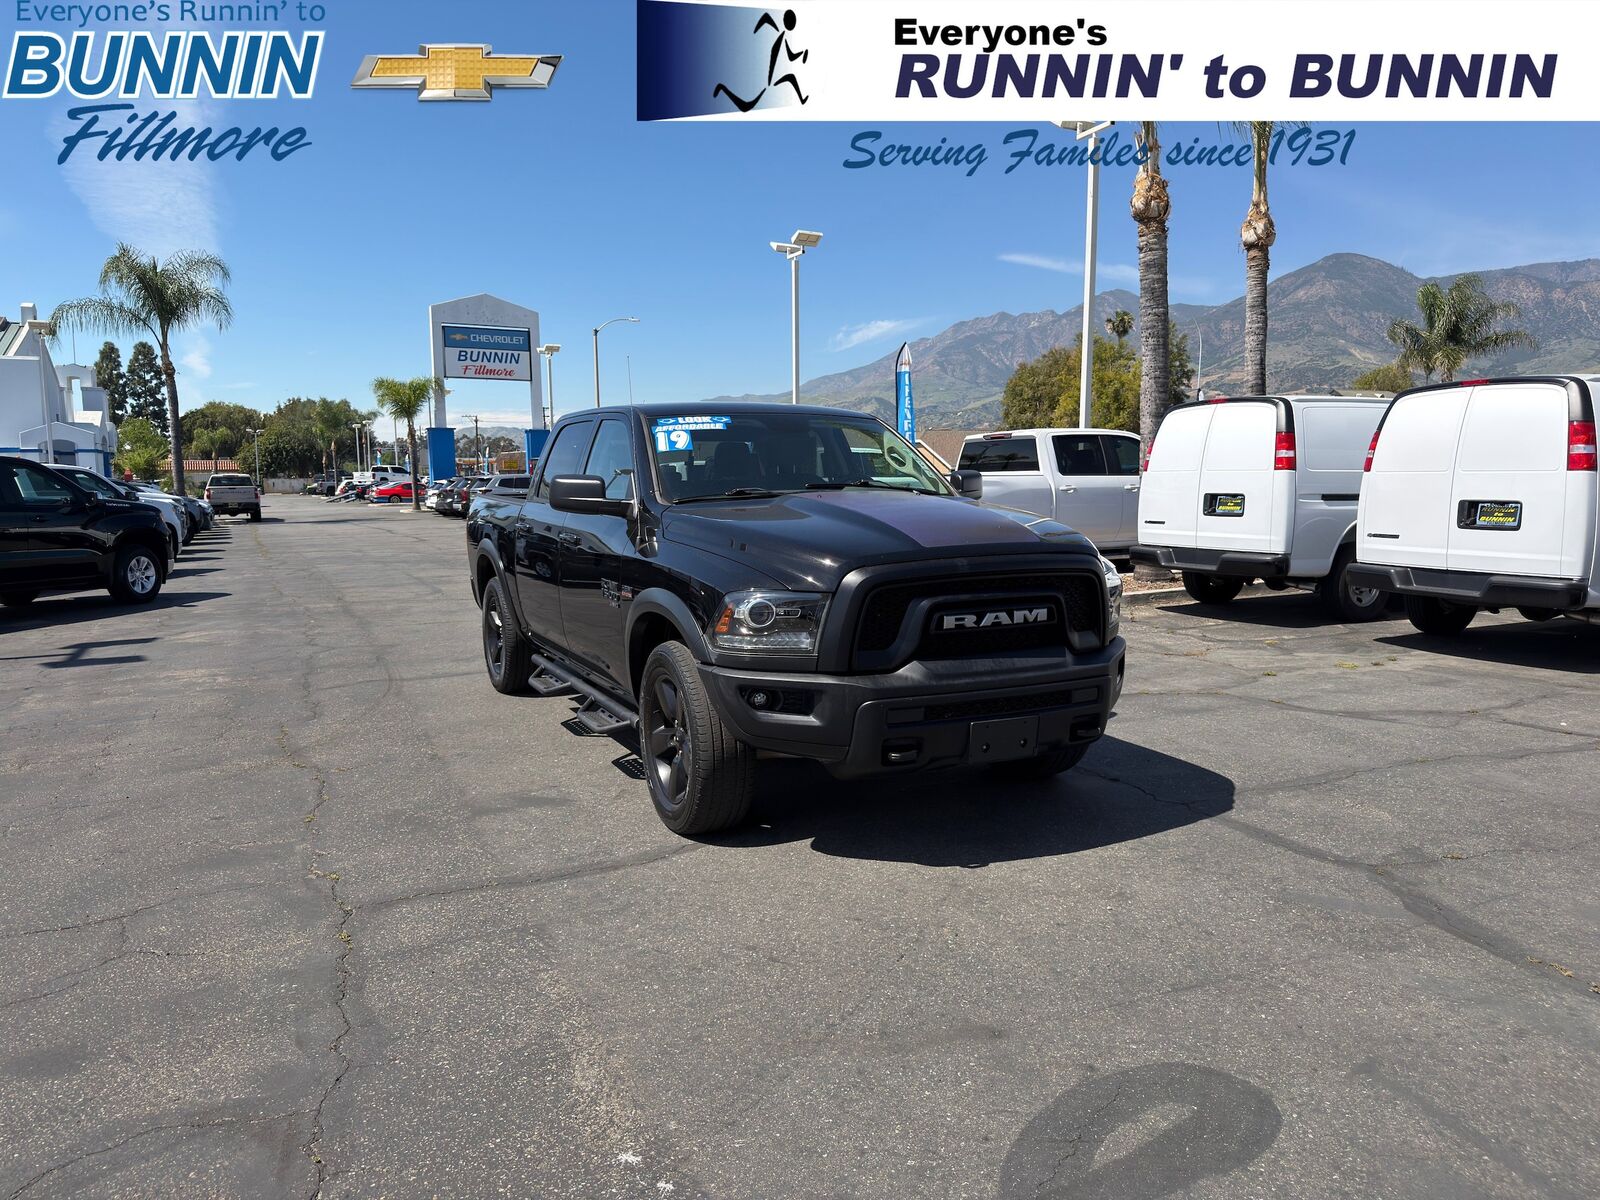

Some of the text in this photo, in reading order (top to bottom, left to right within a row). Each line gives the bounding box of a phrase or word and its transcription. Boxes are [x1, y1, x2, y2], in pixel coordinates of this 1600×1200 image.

[470, 334, 525, 344] CHEVROLET
[457, 350, 520, 364] BUNNIN
[461, 365, 515, 377] Fillmore
[677, 416, 712, 424] LOOK
[655, 423, 724, 432] AFFORDABLE
[656, 430, 690, 452] 19
[943, 607, 1048, 630] RAM
